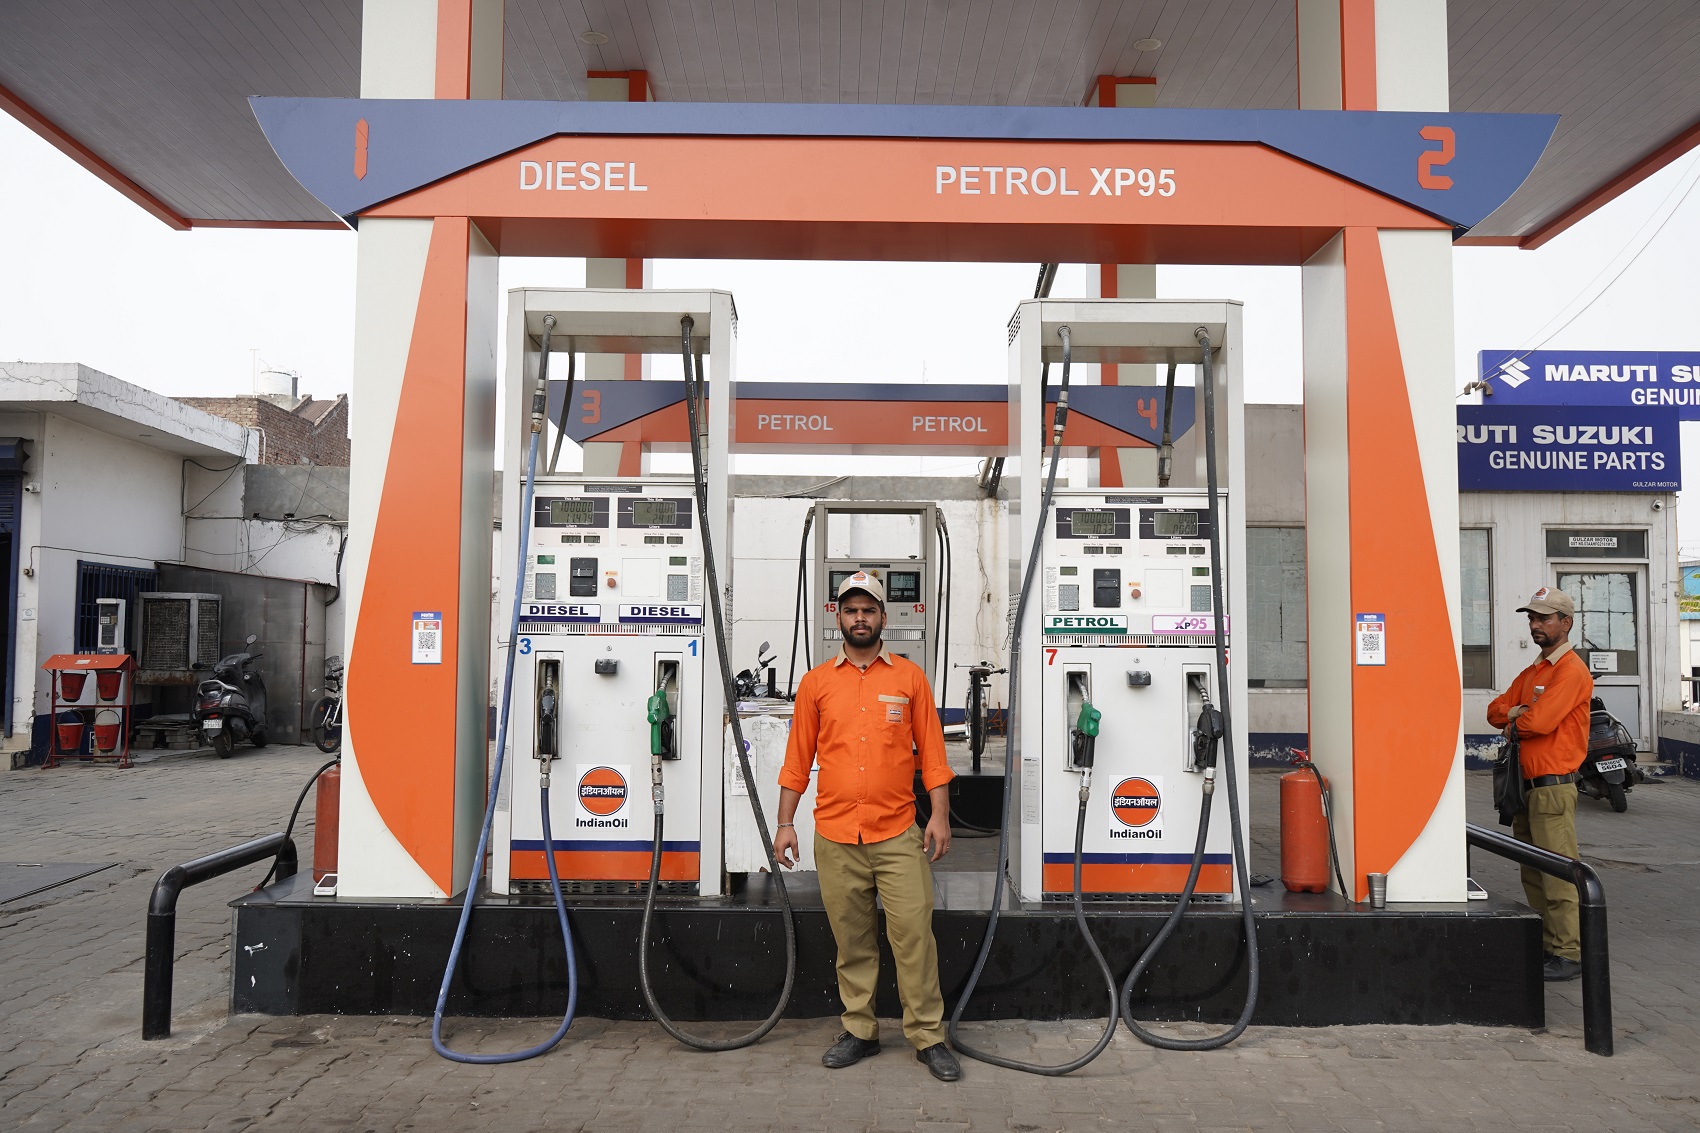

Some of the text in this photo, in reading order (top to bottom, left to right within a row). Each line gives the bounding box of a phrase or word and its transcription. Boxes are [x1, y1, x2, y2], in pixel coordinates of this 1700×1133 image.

[354, 117, 369, 181] 1
[1417, 125, 1456, 190] 2
[519, 160, 648, 191] DIESEL
[935, 165, 1176, 197] PETROL XP95
[1545, 364, 1658, 382] MARUTI
[581, 390, 600, 424] 3
[1137, 397, 1157, 431] 4
[758, 414, 833, 431] PETROL
[912, 416, 988, 432] PETROL
[1532, 425, 1653, 445] SUZUKI
[1489, 450, 1665, 471] GENUINE PARTS
[529, 605, 589, 616] DIESEL
[630, 606, 690, 617] DIESEL
[824, 603, 836, 613] 15
[912, 603, 925, 613] 13
[1052, 617, 1119, 627] PETROL
[1174, 616, 1207, 629] XP95
[519, 637, 532, 655] 3
[688, 639, 698, 657] 1
[1045, 649, 1058, 665] 7
[581, 785, 625, 797] इंडियनऑयल
[1114, 796, 1158, 807] इंडियनऑयल
[575, 817, 628, 828] IndianOil
[1109, 829, 1162, 839] IndianOil
